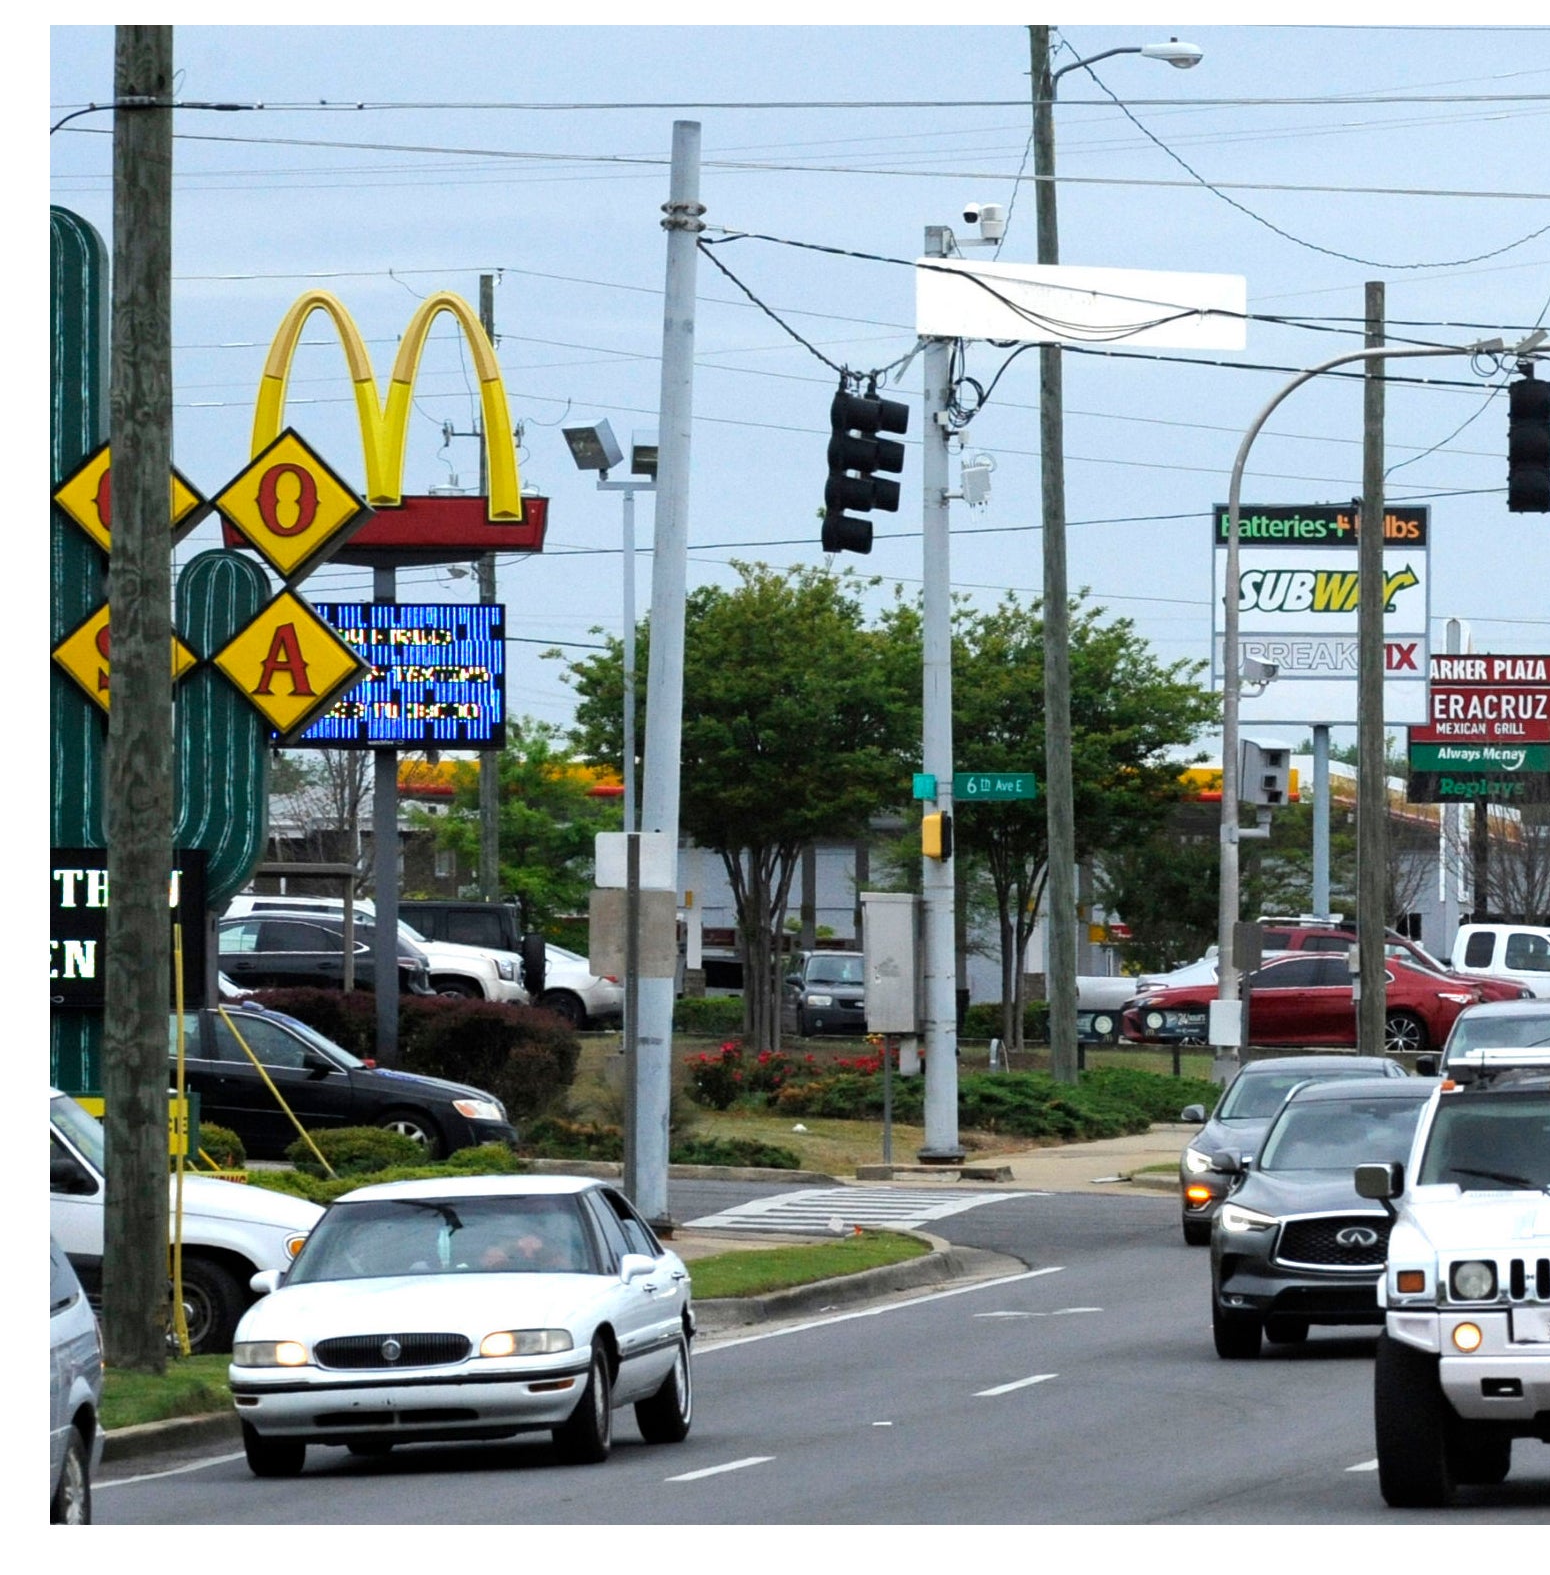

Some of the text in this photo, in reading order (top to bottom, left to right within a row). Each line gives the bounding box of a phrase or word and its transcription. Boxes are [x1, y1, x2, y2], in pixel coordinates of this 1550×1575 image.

[1493, 659, 1547, 681] PLAZA
[1430, 694, 1548, 720] ERACRUZ
[1436, 722, 1526, 735] MEXICAN GRILL
[1437, 747, 1527, 771] Always Money
[995, 779, 1014, 792] Ave
[1016, 779, 1023, 792] E
[1439, 777, 1526, 798] Replays
